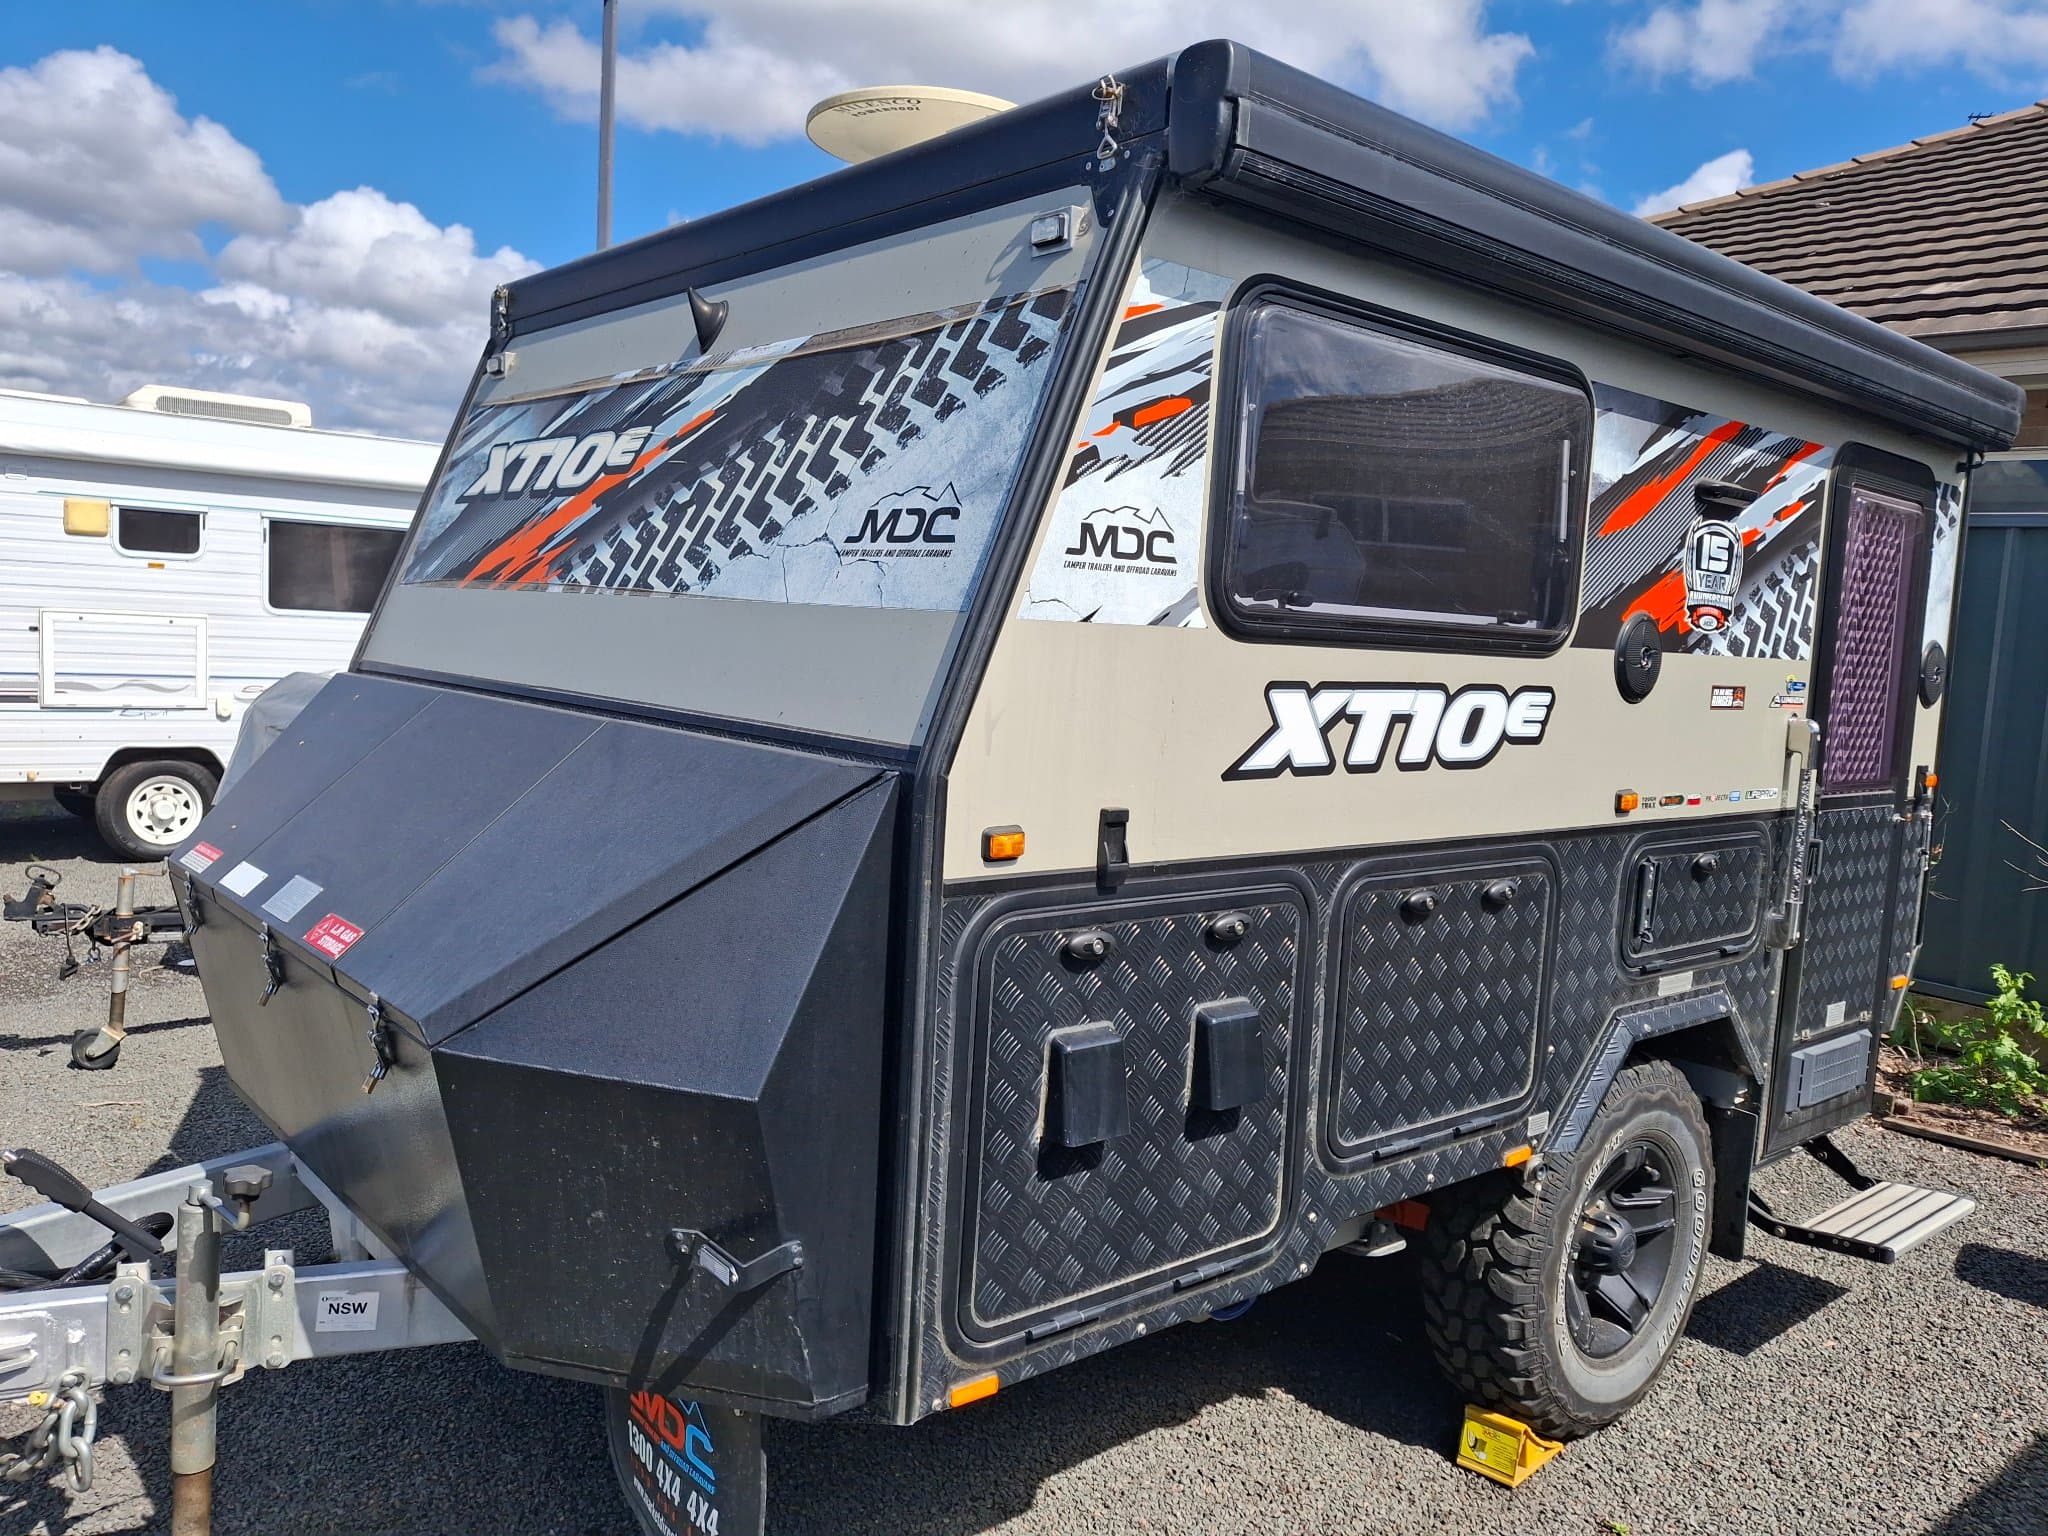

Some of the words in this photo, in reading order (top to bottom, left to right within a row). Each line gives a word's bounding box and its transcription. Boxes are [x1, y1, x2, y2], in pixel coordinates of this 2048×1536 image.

[843, 506, 961, 543] MDC
[1064, 521, 1178, 564] MDC
[884, 549, 897, 558] AND
[1063, 560, 1087, 570] CAMPER
[1087, 562, 1113, 572] TRAILERS
[1113, 564, 1125, 573] AND
[1126, 565, 1150, 575] OFFROAD
[1150, 567, 1178, 577] CARAVANS
[1698, 572, 1727, 591] YEAR
[340, 929, 358, 943] GAS
[328, 1302, 368, 1315] NSW
[627, 1419, 654, 1473] 1300
[656, 1458, 681, 1507] 4X4
[686, 1490, 719, 1536] 4X4
